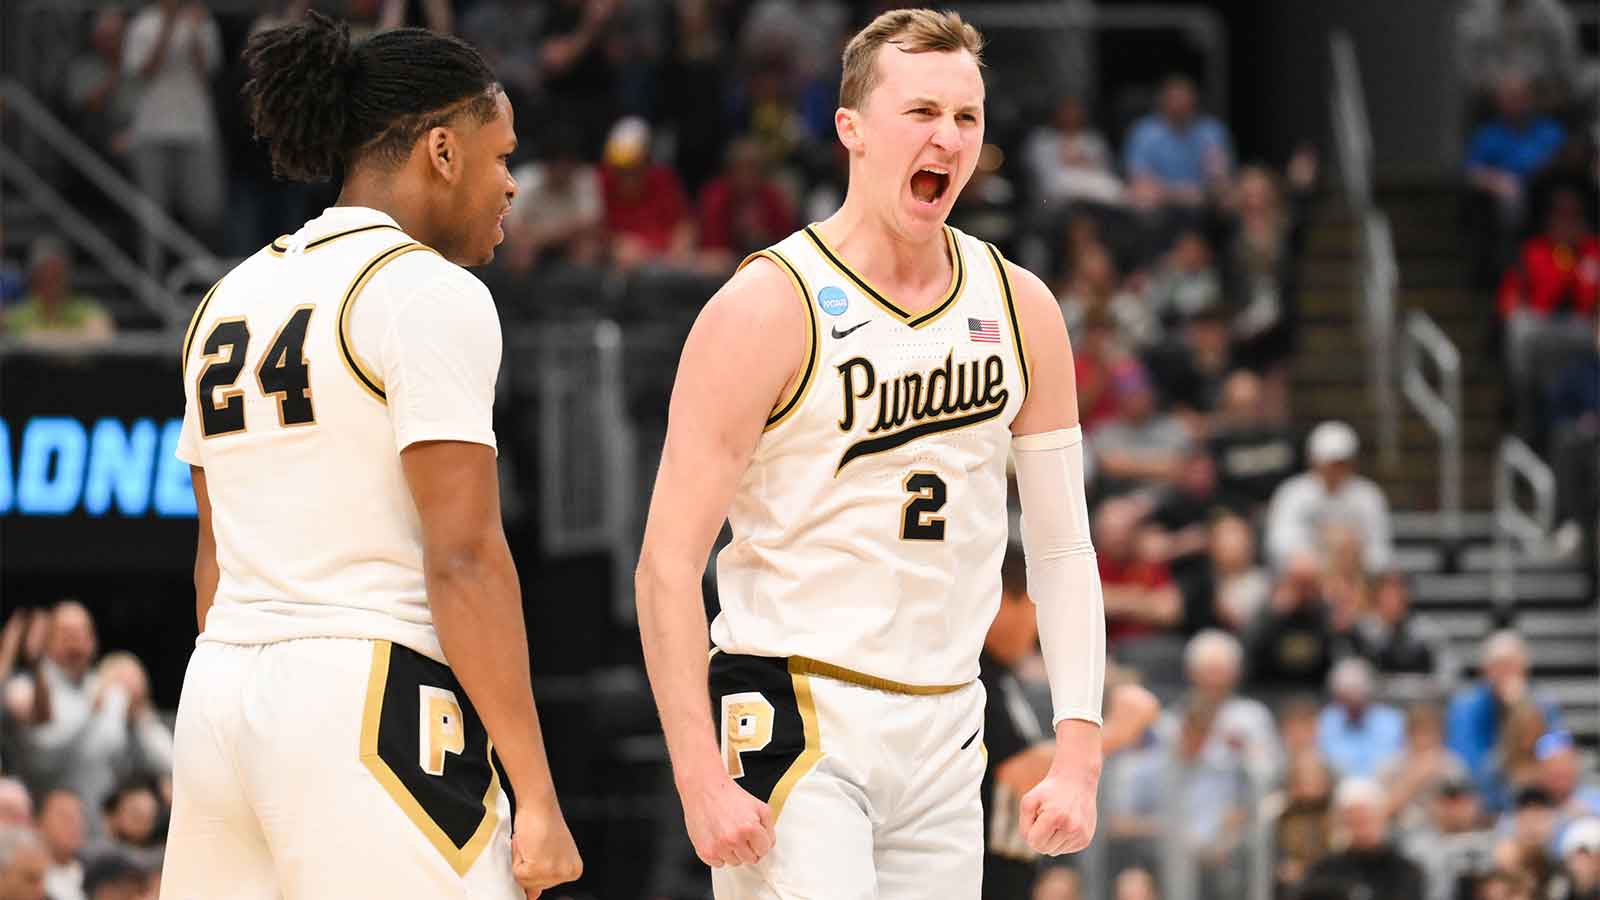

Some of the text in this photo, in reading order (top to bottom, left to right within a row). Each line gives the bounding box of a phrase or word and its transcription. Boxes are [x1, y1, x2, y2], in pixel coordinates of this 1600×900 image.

[197, 304, 317, 439] 24
[835, 348, 1010, 477] Purdue
[900, 470, 948, 542] 2
[418, 684, 465, 777] P
[720, 691, 775, 780] P
